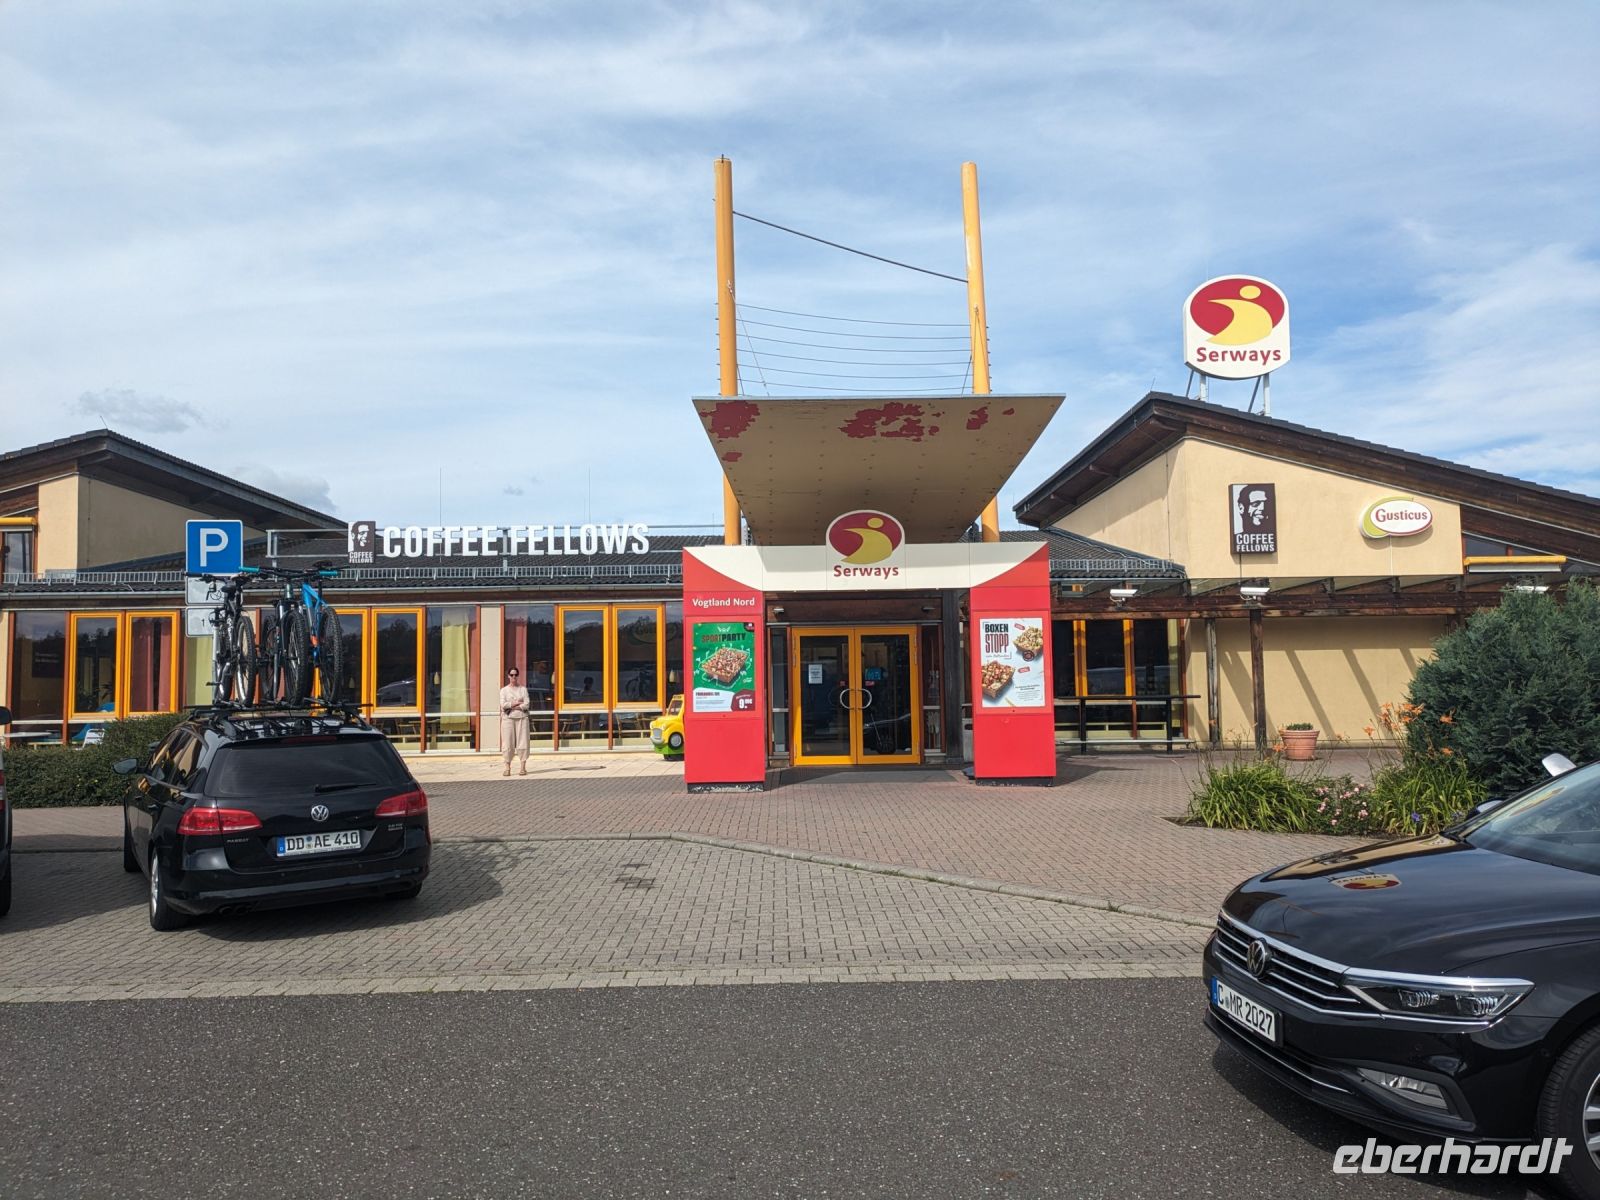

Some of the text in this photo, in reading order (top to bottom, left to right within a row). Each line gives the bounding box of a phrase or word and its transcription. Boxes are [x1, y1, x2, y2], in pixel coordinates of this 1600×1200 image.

[1196, 346, 1281, 366] Serways
[1375, 508, 1428, 523] Gusticus
[199, 527, 229, 567] P
[383, 523, 650, 558] COFFEE FELLOWS
[1236, 533, 1274, 544] COFFEE
[348, 551, 373, 559] COFFEE
[1236, 544, 1275, 553] FELLOWS
[833, 563, 899, 580] Serways
[692, 598, 755, 609] Vogtland Nord
[984, 623, 1009, 633] BOXEN
[985, 633, 1009, 653] STOPP
[286, 837, 305, 851] DD
[314, 834, 332, 848] AE
[334, 832, 359, 845] 410
[1218, 984, 1273, 1036] C MR 2027
